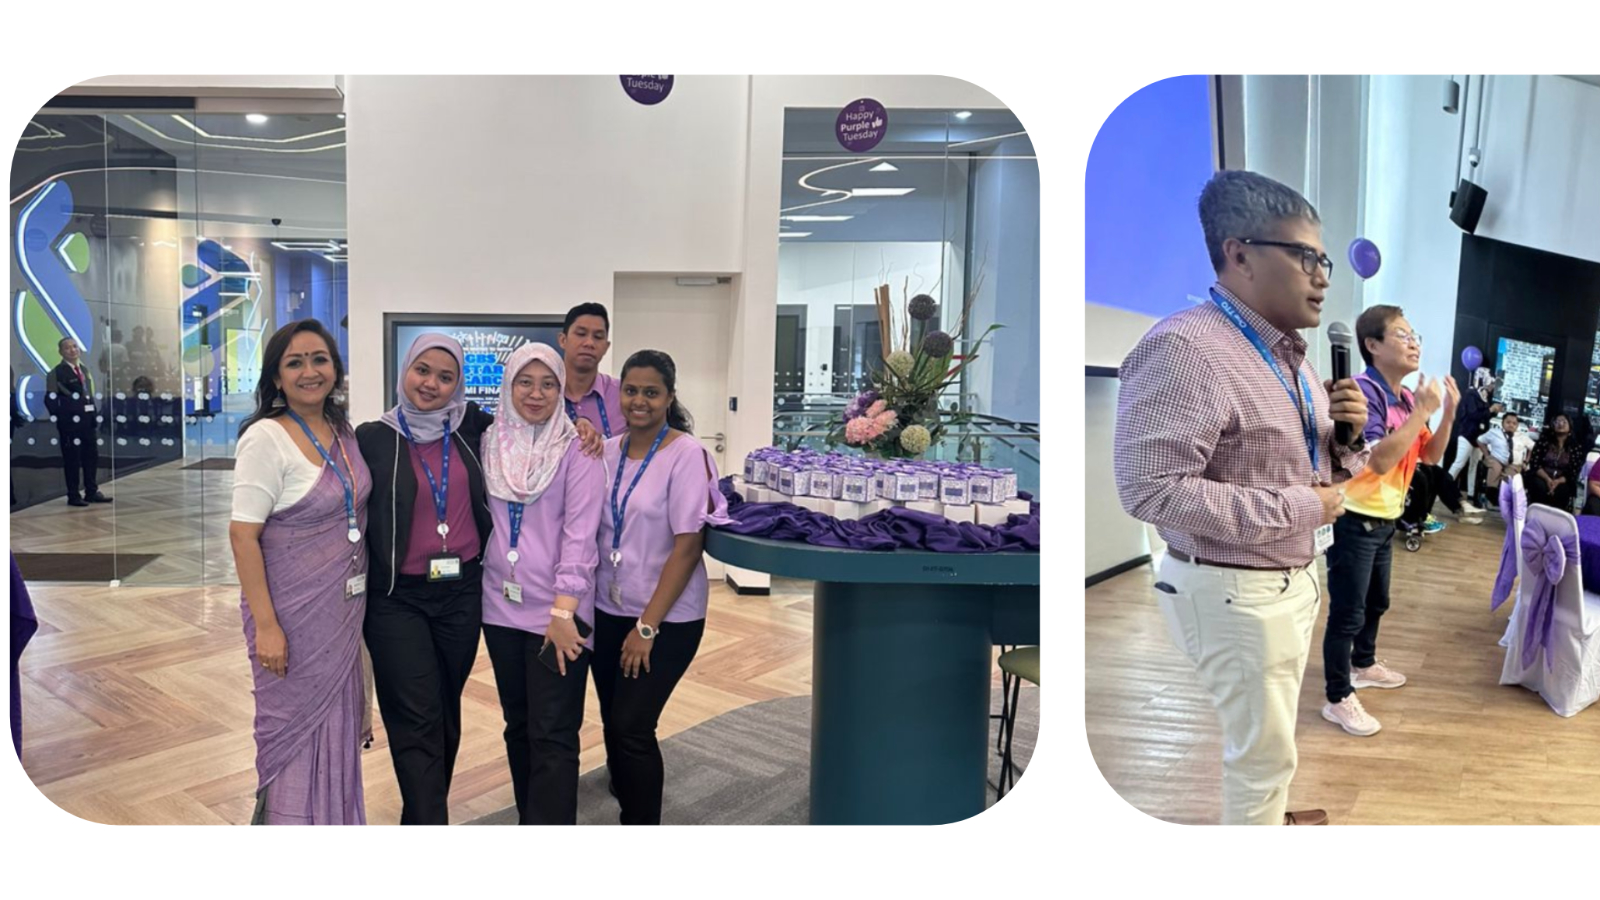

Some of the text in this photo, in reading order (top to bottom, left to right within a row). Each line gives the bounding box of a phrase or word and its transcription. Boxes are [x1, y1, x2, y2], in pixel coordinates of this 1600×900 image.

[627, 77, 664, 93] Tuesday
[845, 111, 874, 121] Happy
[841, 120, 870, 132] Purple
[843, 130, 879, 141] Tuesday
